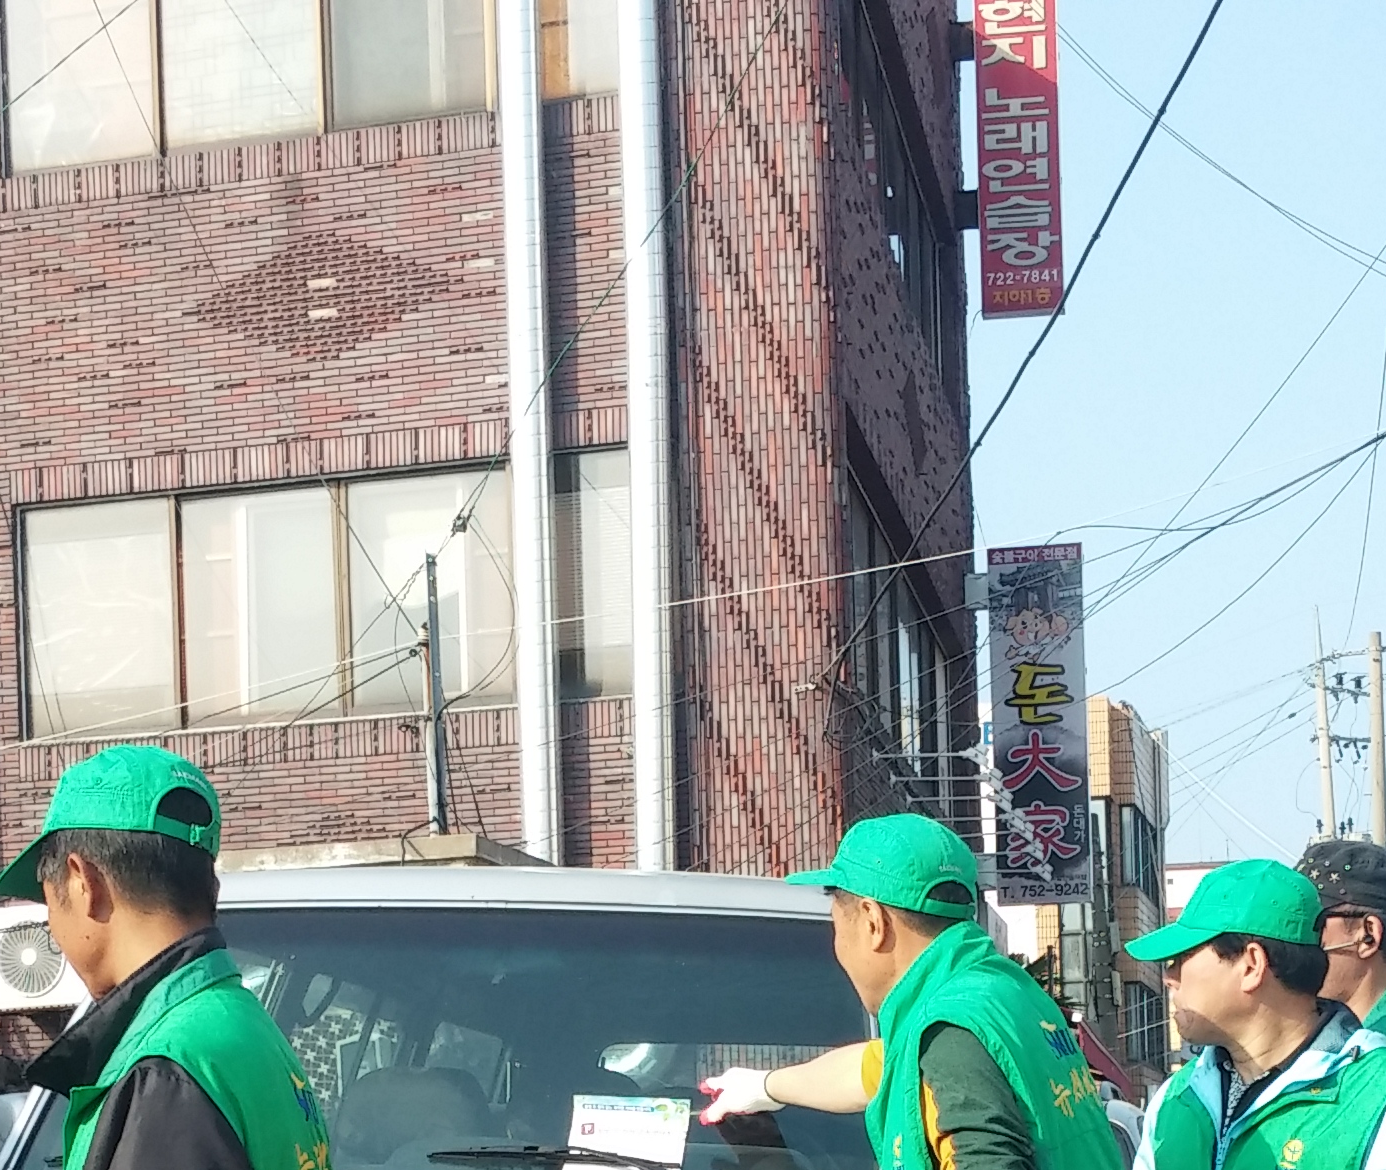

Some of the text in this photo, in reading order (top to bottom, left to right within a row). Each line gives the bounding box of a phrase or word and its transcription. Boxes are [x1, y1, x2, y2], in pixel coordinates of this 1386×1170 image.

[981, 88, 1059, 267] 노래연습장
[986, 269, 1059, 287] 722-7841
[992, 288, 1052, 306] 지하1층
[992, 546, 1078, 564] 숯불구이 전문점
[1072, 803, 1087, 844] 돈대가
[1021, 882, 1088, 898] 752-9242
